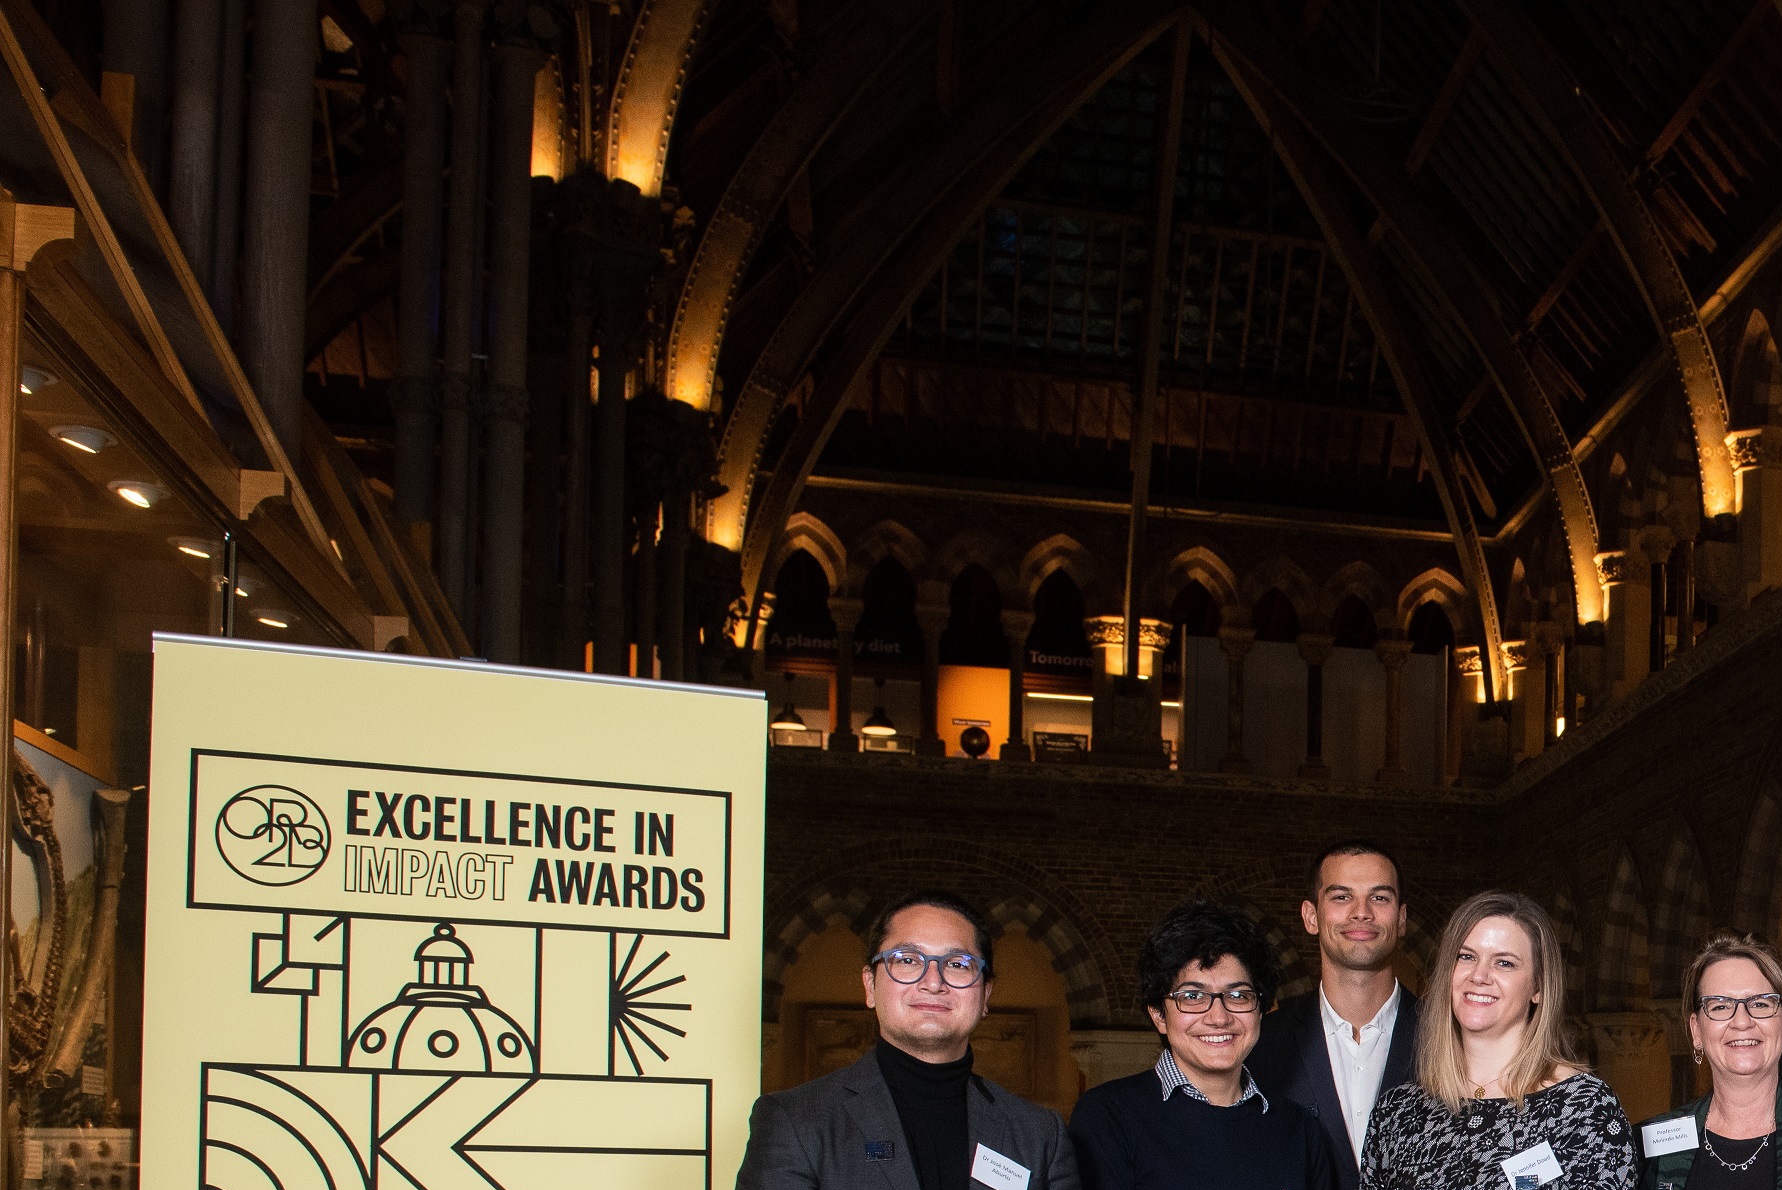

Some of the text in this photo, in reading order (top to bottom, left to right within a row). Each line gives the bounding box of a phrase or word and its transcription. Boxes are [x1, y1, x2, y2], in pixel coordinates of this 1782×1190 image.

[770, 632, 900, 654] A planety diet
[347, 789, 674, 857] EXCELLENCE IN
[344, 844, 705, 913] IMPACT AWARDS
